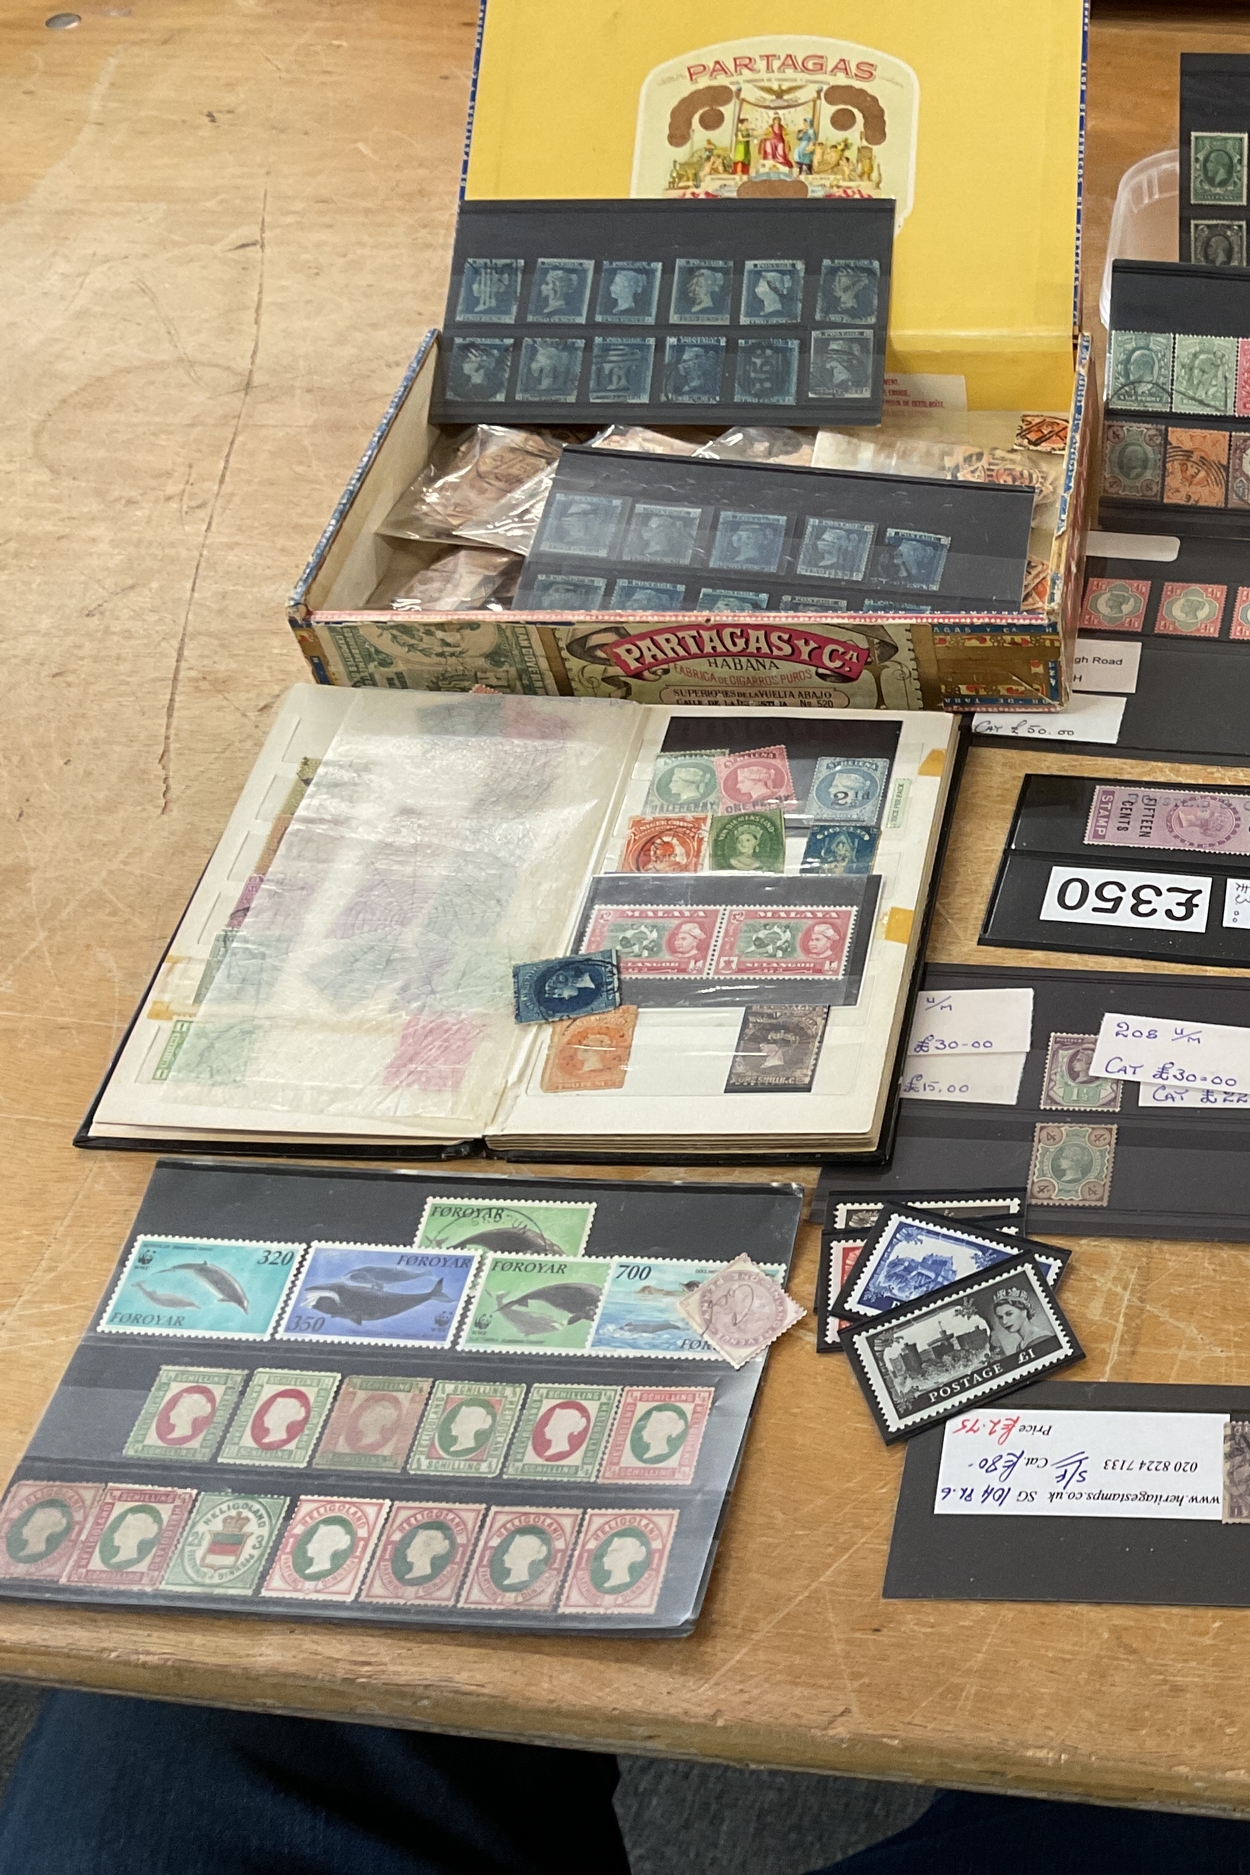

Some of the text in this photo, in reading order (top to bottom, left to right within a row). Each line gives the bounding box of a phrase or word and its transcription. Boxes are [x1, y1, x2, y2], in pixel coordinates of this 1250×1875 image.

[686, 53, 877, 84] PARTAGAS
[612, 628, 795, 671] PARTAGAS
[707, 657, 781, 672] HABANA
[1074, 656, 1123, 666] gh Road
[673, 662, 718, 684] FABRICA
[779, 669, 813, 685] PUROS
[758, 689, 795, 699] VUELTA
[797, 689, 833, 700] ABAJO
[725, 801, 750, 813] ONE
[1096, 793, 1113, 837] STAMP
[1116, 800, 1133, 832] CENTS
[1138, 797, 1159, 838] FIFTEEN
[1056, 876, 1204, 922] £350
[623, 909, 707, 919] MALAYA
[756, 909, 840, 919] MALAYA
[1103, 1056, 1144, 1077] CAT
[430, 1206, 506, 1220] FØROYAR
[257, 1250, 295, 1266] 320
[396, 1254, 472, 1270] FØROYAR
[491, 1260, 568, 1276] FØROYAR
[615, 1264, 653, 1281] 700
[109, 1310, 187, 1328] FØROYAR
[288, 1315, 326, 1333] 350
[1017, 1348, 1037, 1365] £1
[452, 1384, 508, 1397] SCHILLING
[927, 1362, 1004, 1403] POSTAGE
[548, 1389, 602, 1400] SCHILLING
[640, 1391, 695, 1403] SCHILLING
[1018, 1423, 1052, 1436] Price
[1023, 1455, 1049, 1469] Cat.
[1103, 1457, 1199, 1473] 020 8224 7133
[1017, 1490, 1038, 1502] SG
[1047, 1489, 1221, 1507] www.heritagestamps.co.uk
[202, 1502, 268, 1531] HELIGOLAND
[301, 1503, 366, 1531] HELIGOLAND
[400, 1509, 467, 1537] HELIGOLAND
[498, 1515, 565, 1541] HELIGOLAND
[593, 1515, 661, 1542] HELIGOLAND
